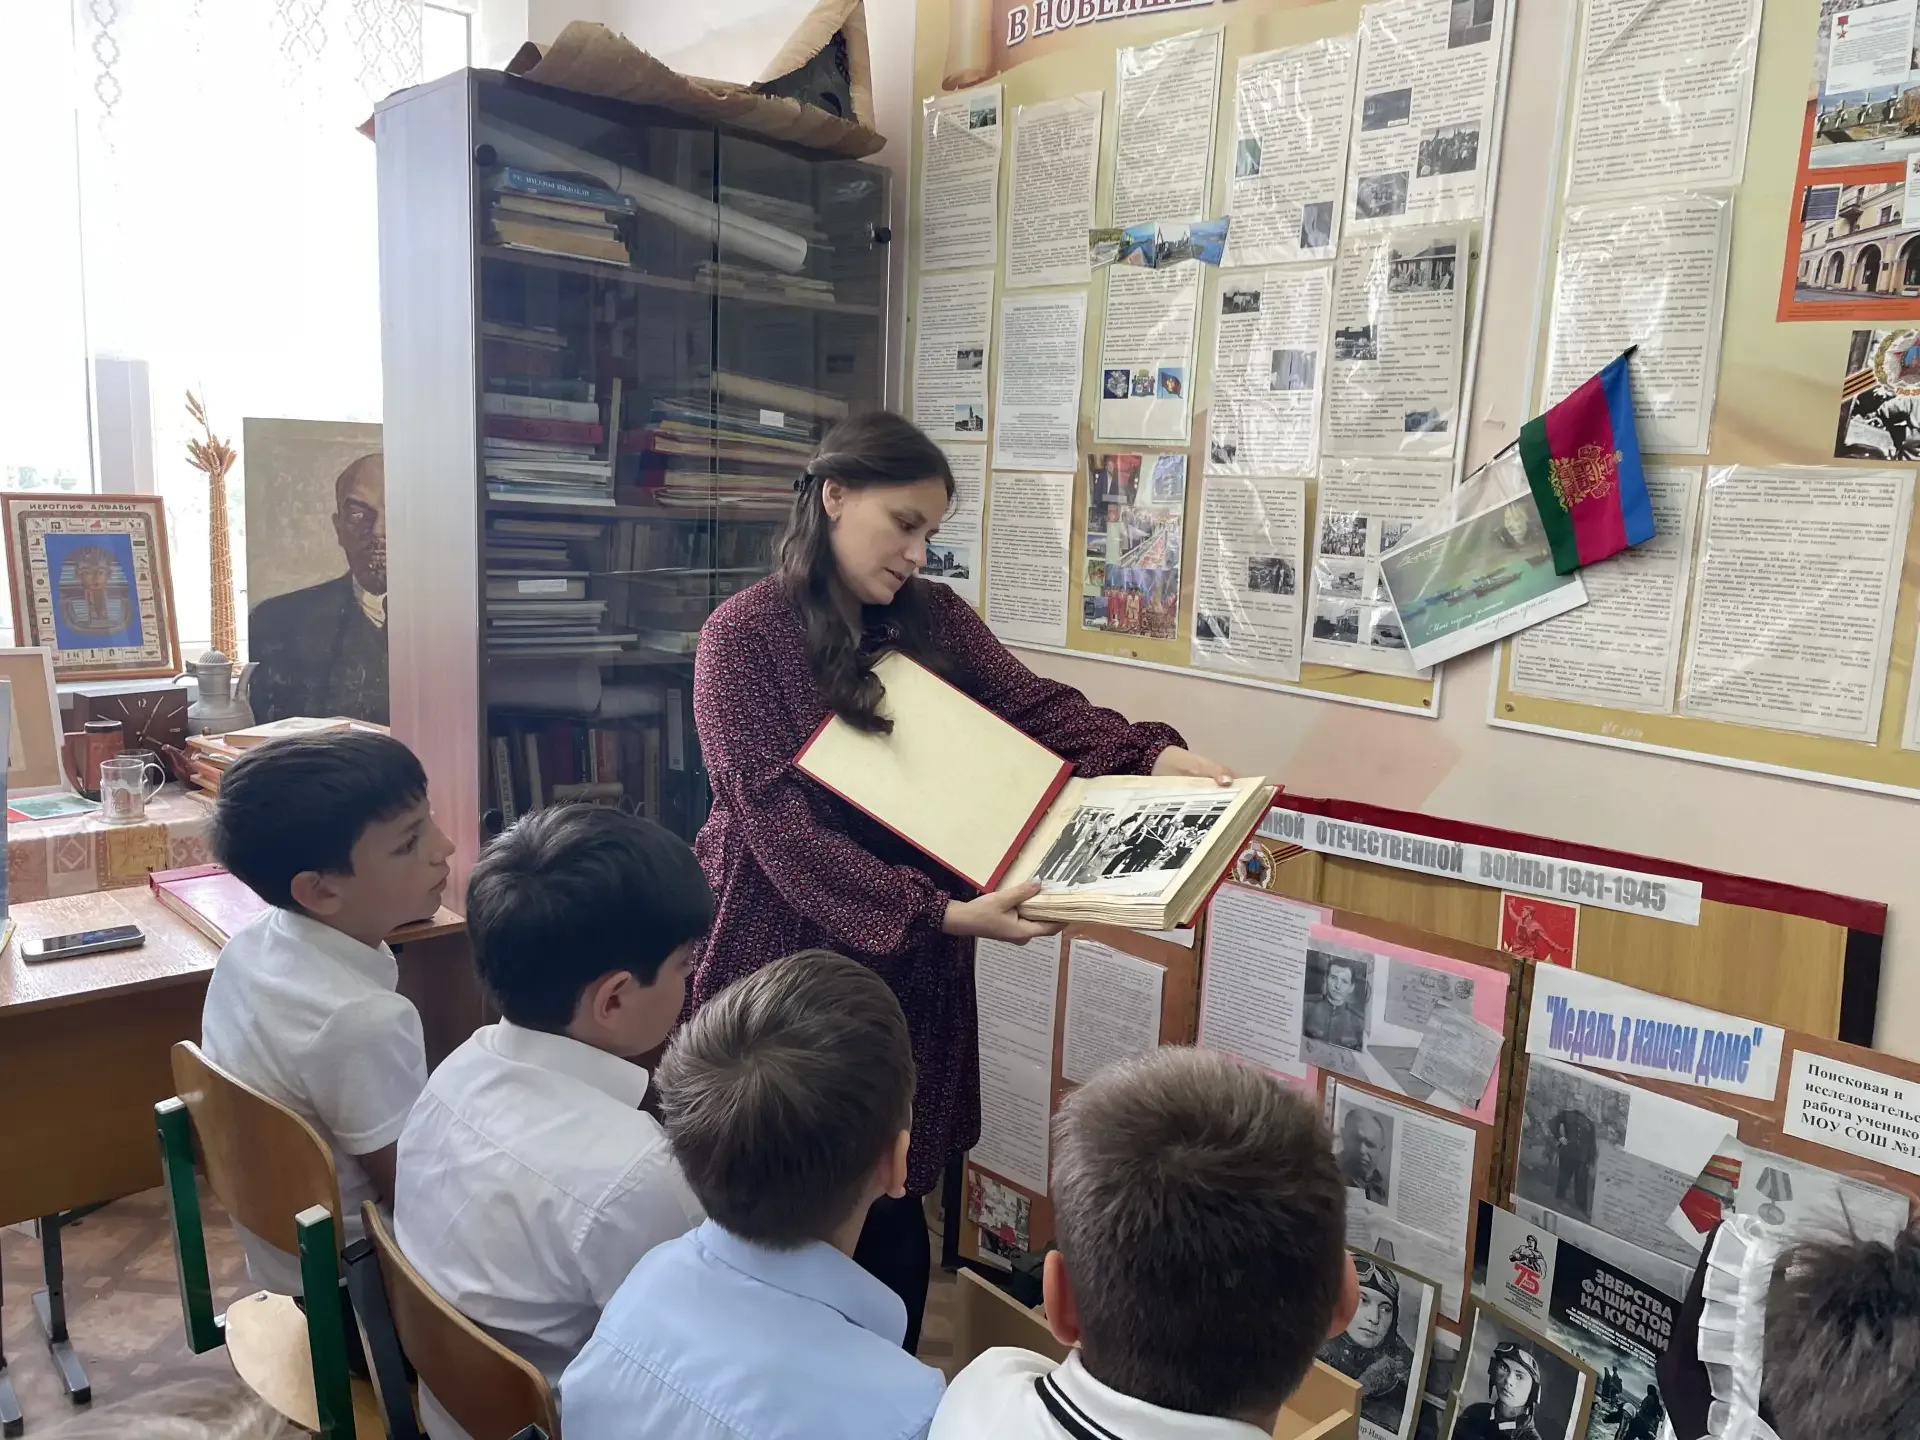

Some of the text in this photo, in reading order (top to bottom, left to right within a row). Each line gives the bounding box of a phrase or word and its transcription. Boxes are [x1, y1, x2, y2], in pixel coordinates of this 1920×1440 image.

[1008, 8, 1028, 46] В
[136, 697, 146, 707] 12
[1258, 811, 1666, 911] ИКОЙ ОТЕЧЕСТВЕННОЙ ВОЙНЫ 1941-1945
[1546, 995, 1763, 1086] "Медаль в нашем доме"
[1808, 1063, 1903, 1100] Поисковая и
[1802, 1098, 1852, 1120] работа
[1800, 1112, 1840, 1132] МОУ
[1845, 1126, 1887, 1148] СОШ
[1514, 1264, 1540, 1296] 75
[1595, 1268, 1673, 1322] ЗВЕРСТВА
[1580, 1291, 1602, 1315] НА
[1604, 1305, 1670, 1351] КУБАНИ
[1581, 1278, 1672, 1337] ФАШИСТОВ
